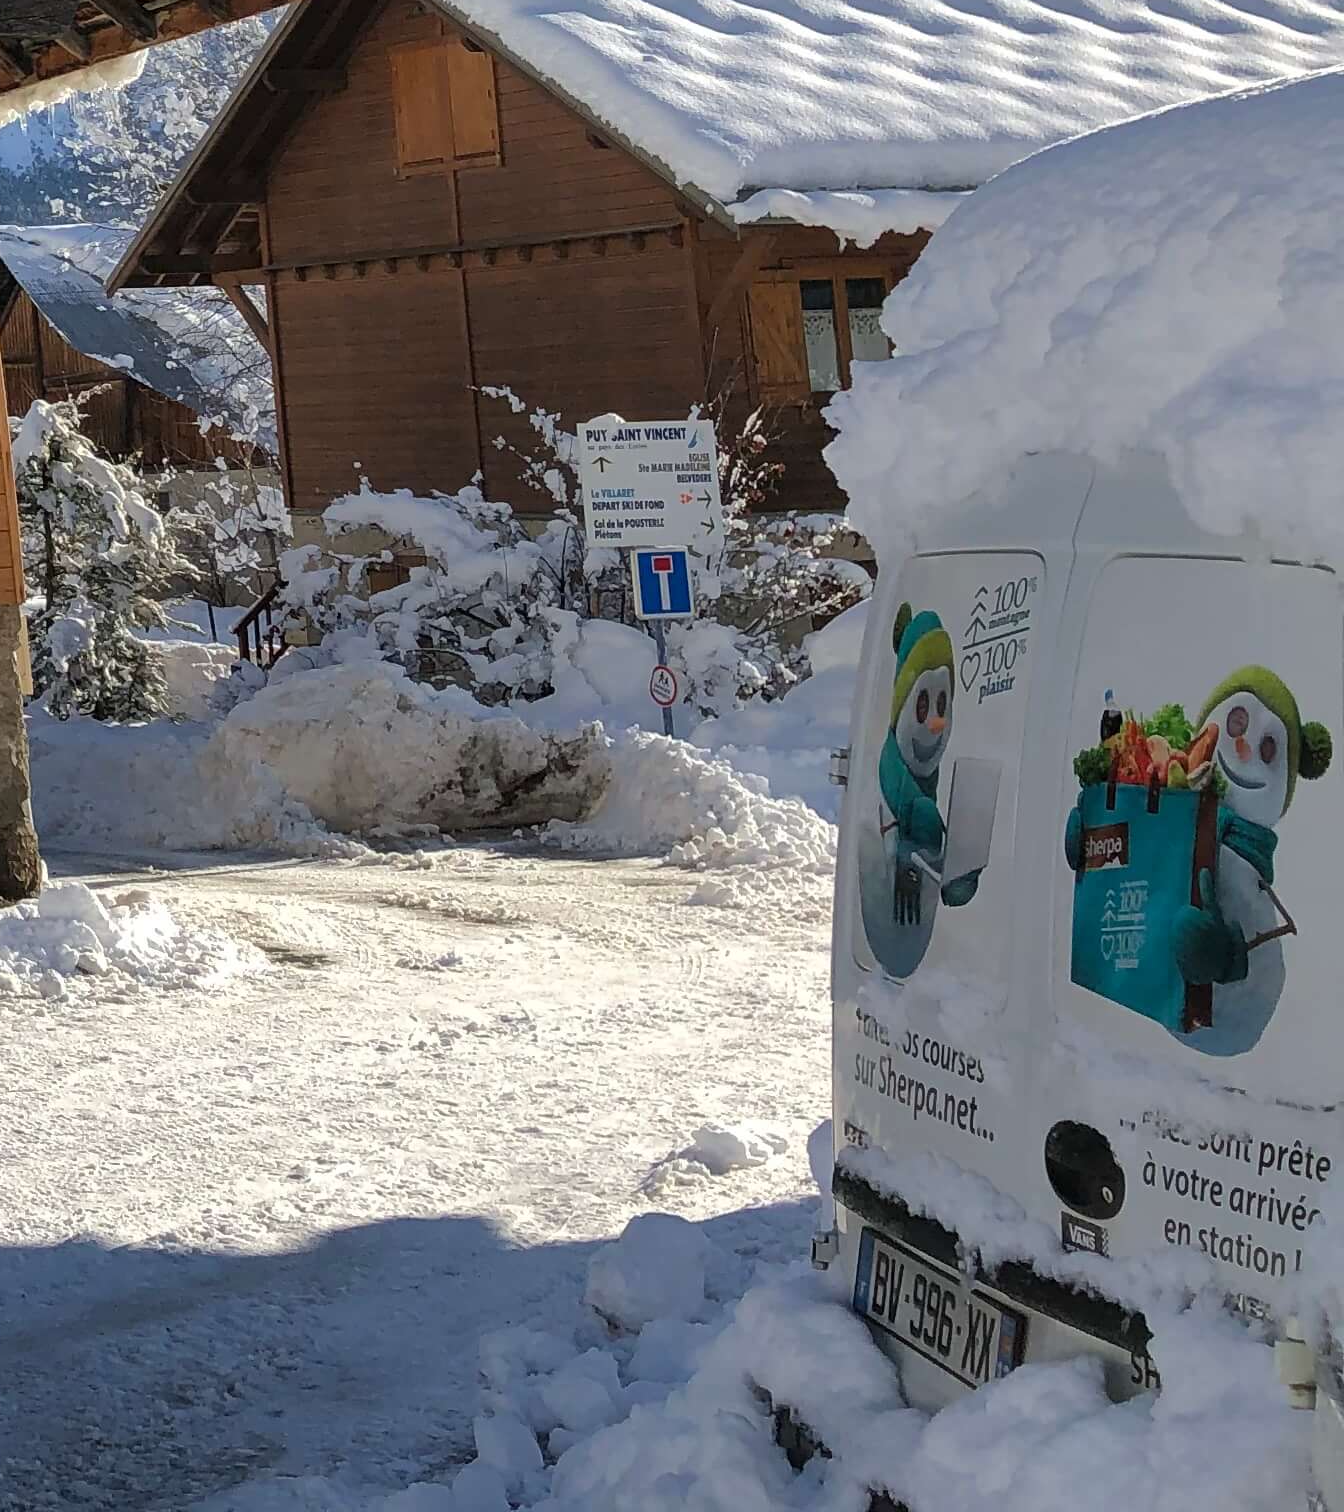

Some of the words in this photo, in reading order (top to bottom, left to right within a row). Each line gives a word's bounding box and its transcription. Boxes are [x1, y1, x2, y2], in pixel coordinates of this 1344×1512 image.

[586, 430, 607, 442] PUY
[644, 428, 687, 441] VINCENT
[592, 500, 620, 511] DEPART
[622, 500, 634, 510] SKI
[635, 500, 644, 510] DE
[645, 500, 665, 509] FOND
[594, 518, 606, 528] Col
[607, 518, 616, 528] de
[978, 672, 1016, 705] plaisir
[855, 1054, 877, 1089] sur
[878, 1056, 995, 1142] Sherpa.net...
[1142, 1151, 1156, 1187] à
[1162, 1165, 1223, 1207] votre
[1068, 1222, 1096, 1251] VANS
[1164, 1218, 1191, 1246] en
[1198, 1227, 1286, 1277] station
